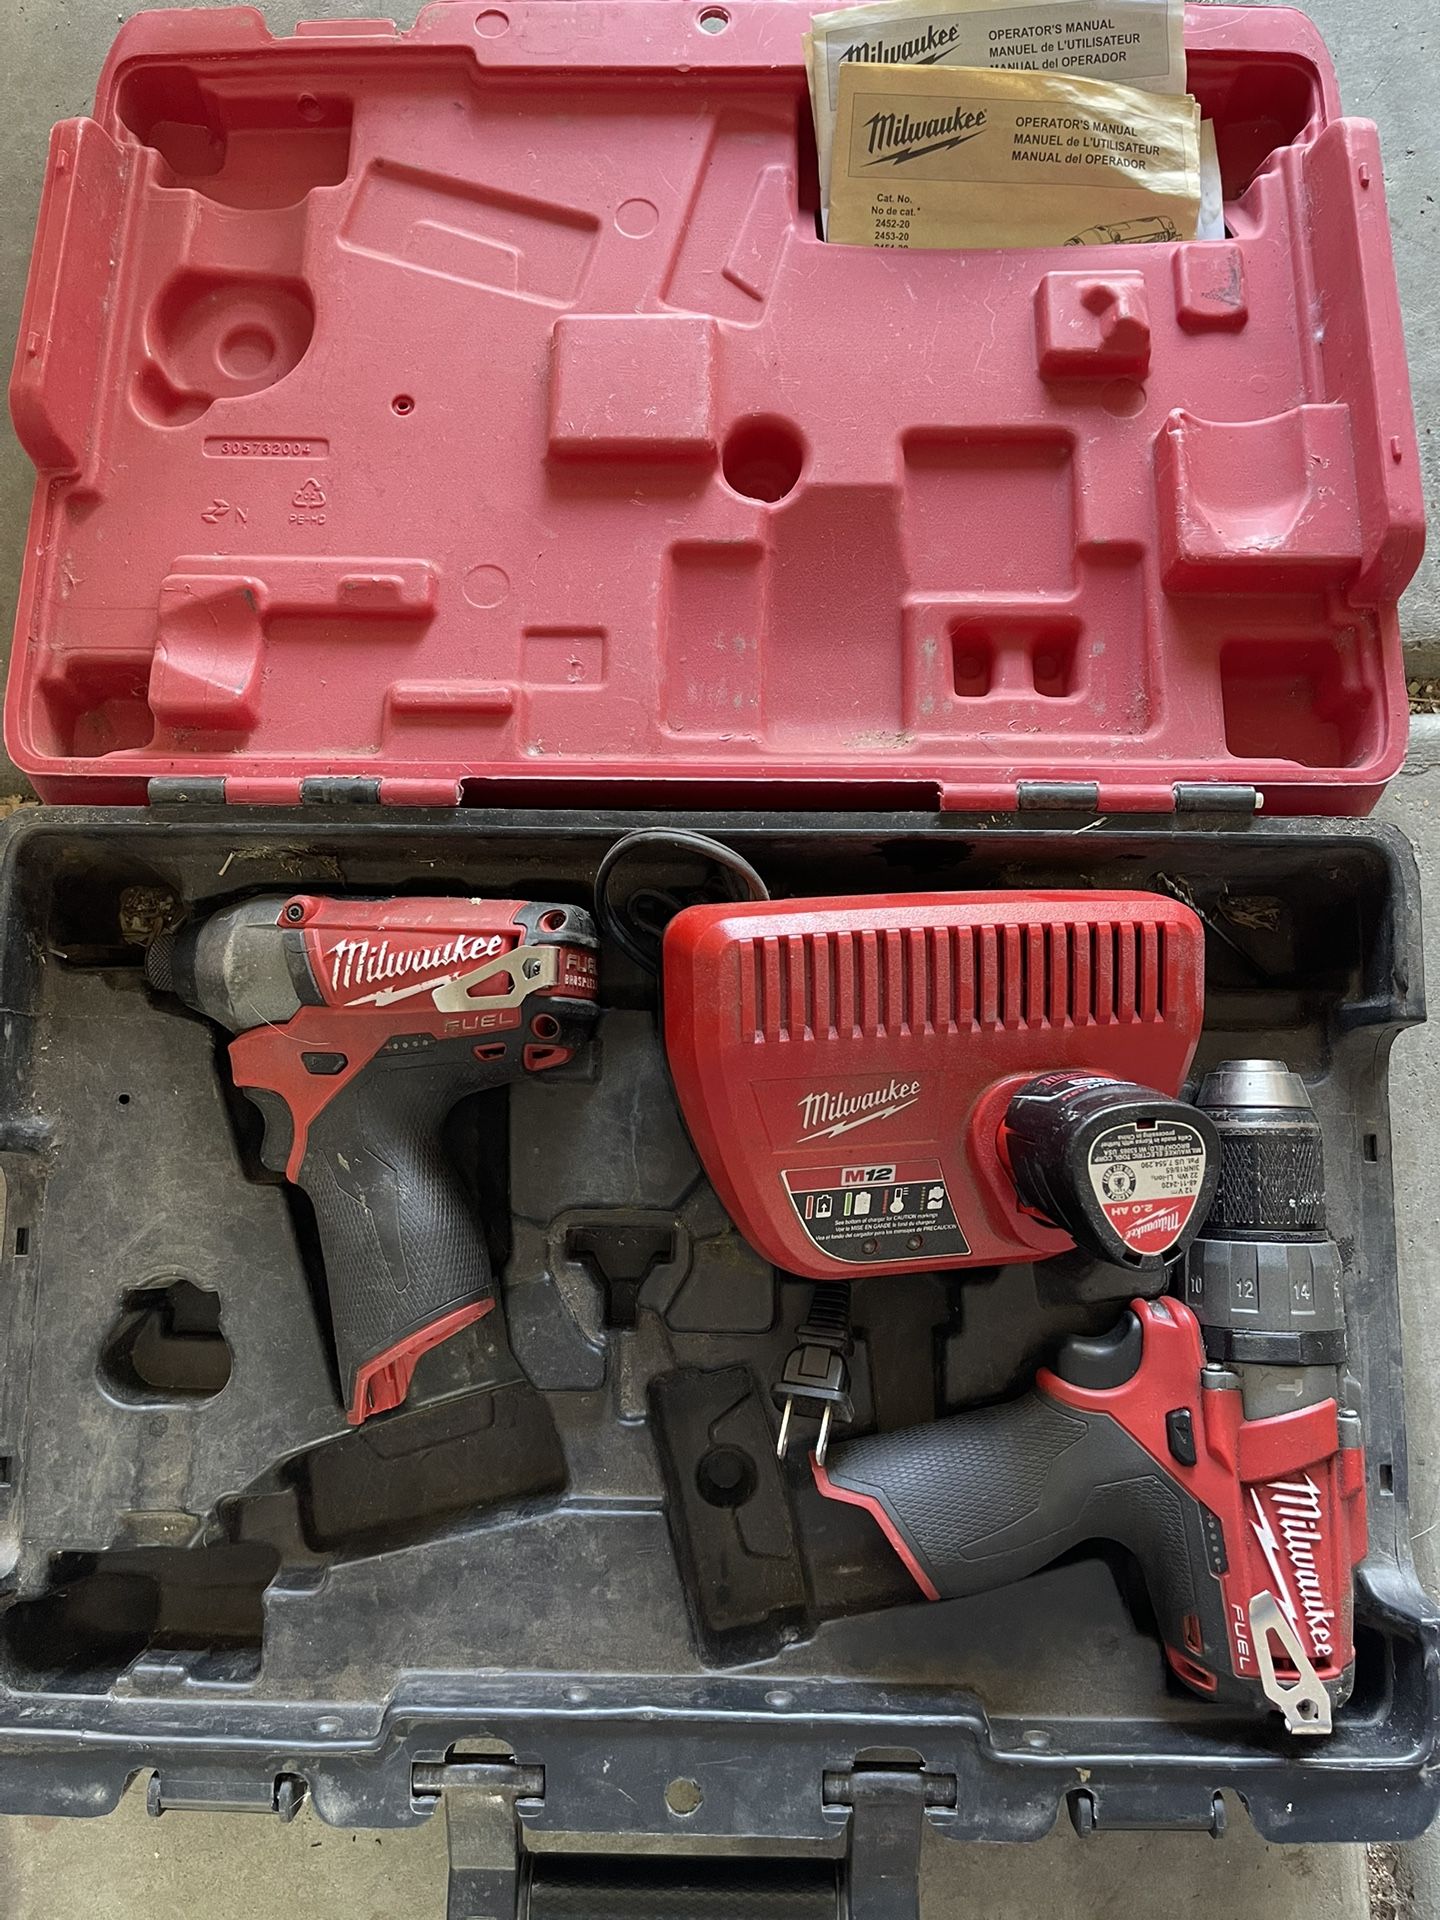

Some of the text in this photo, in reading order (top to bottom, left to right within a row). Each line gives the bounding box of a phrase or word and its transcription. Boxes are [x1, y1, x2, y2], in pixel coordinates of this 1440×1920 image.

[988, 19, 1115, 40] OPERATOR'S MANUAL
[989, 33, 1141, 58] MANUEL de L'UTILISATEUR
[990, 51, 1127, 70] NUAL del OPERADOR
[863, 106, 987, 154] Milwaukee
[1015, 116, 1138, 137] OPERATOR'S MANUAL
[1013, 133, 1160, 156] MANUEL de L'UTILISATEUR
[1011, 150, 1146, 170] MANUAL del OPERADOR
[877, 193, 912, 204] Cat. No.
[872, 206, 884, 215] No
[886, 206, 897, 215] de
[875, 219, 910, 229] 2452-20
[874, 231, 909, 241] 2453-20
[221, 442, 311, 455] 305732004
[324, 934, 502, 992] Milwaukee
[444, 1013, 514, 1032] FUEL
[798, 1080, 920, 1130] Milwaukee
[844, 1168, 892, 1182] M12
[1161, 1180, 1197, 1188] 48-11-2420
[1111, 1204, 1152, 1216] 2.0 AH
[1125, 1211, 1182, 1240] Milwaukee
[1190, 1278, 1202, 1294] 10
[1236, 1280, 1254, 1299] 12
[1293, 1281, 1311, 1300] 14
[1266, 1472, 1334, 1656] Milwaukee
[1232, 1603, 1250, 1670] FUEL
